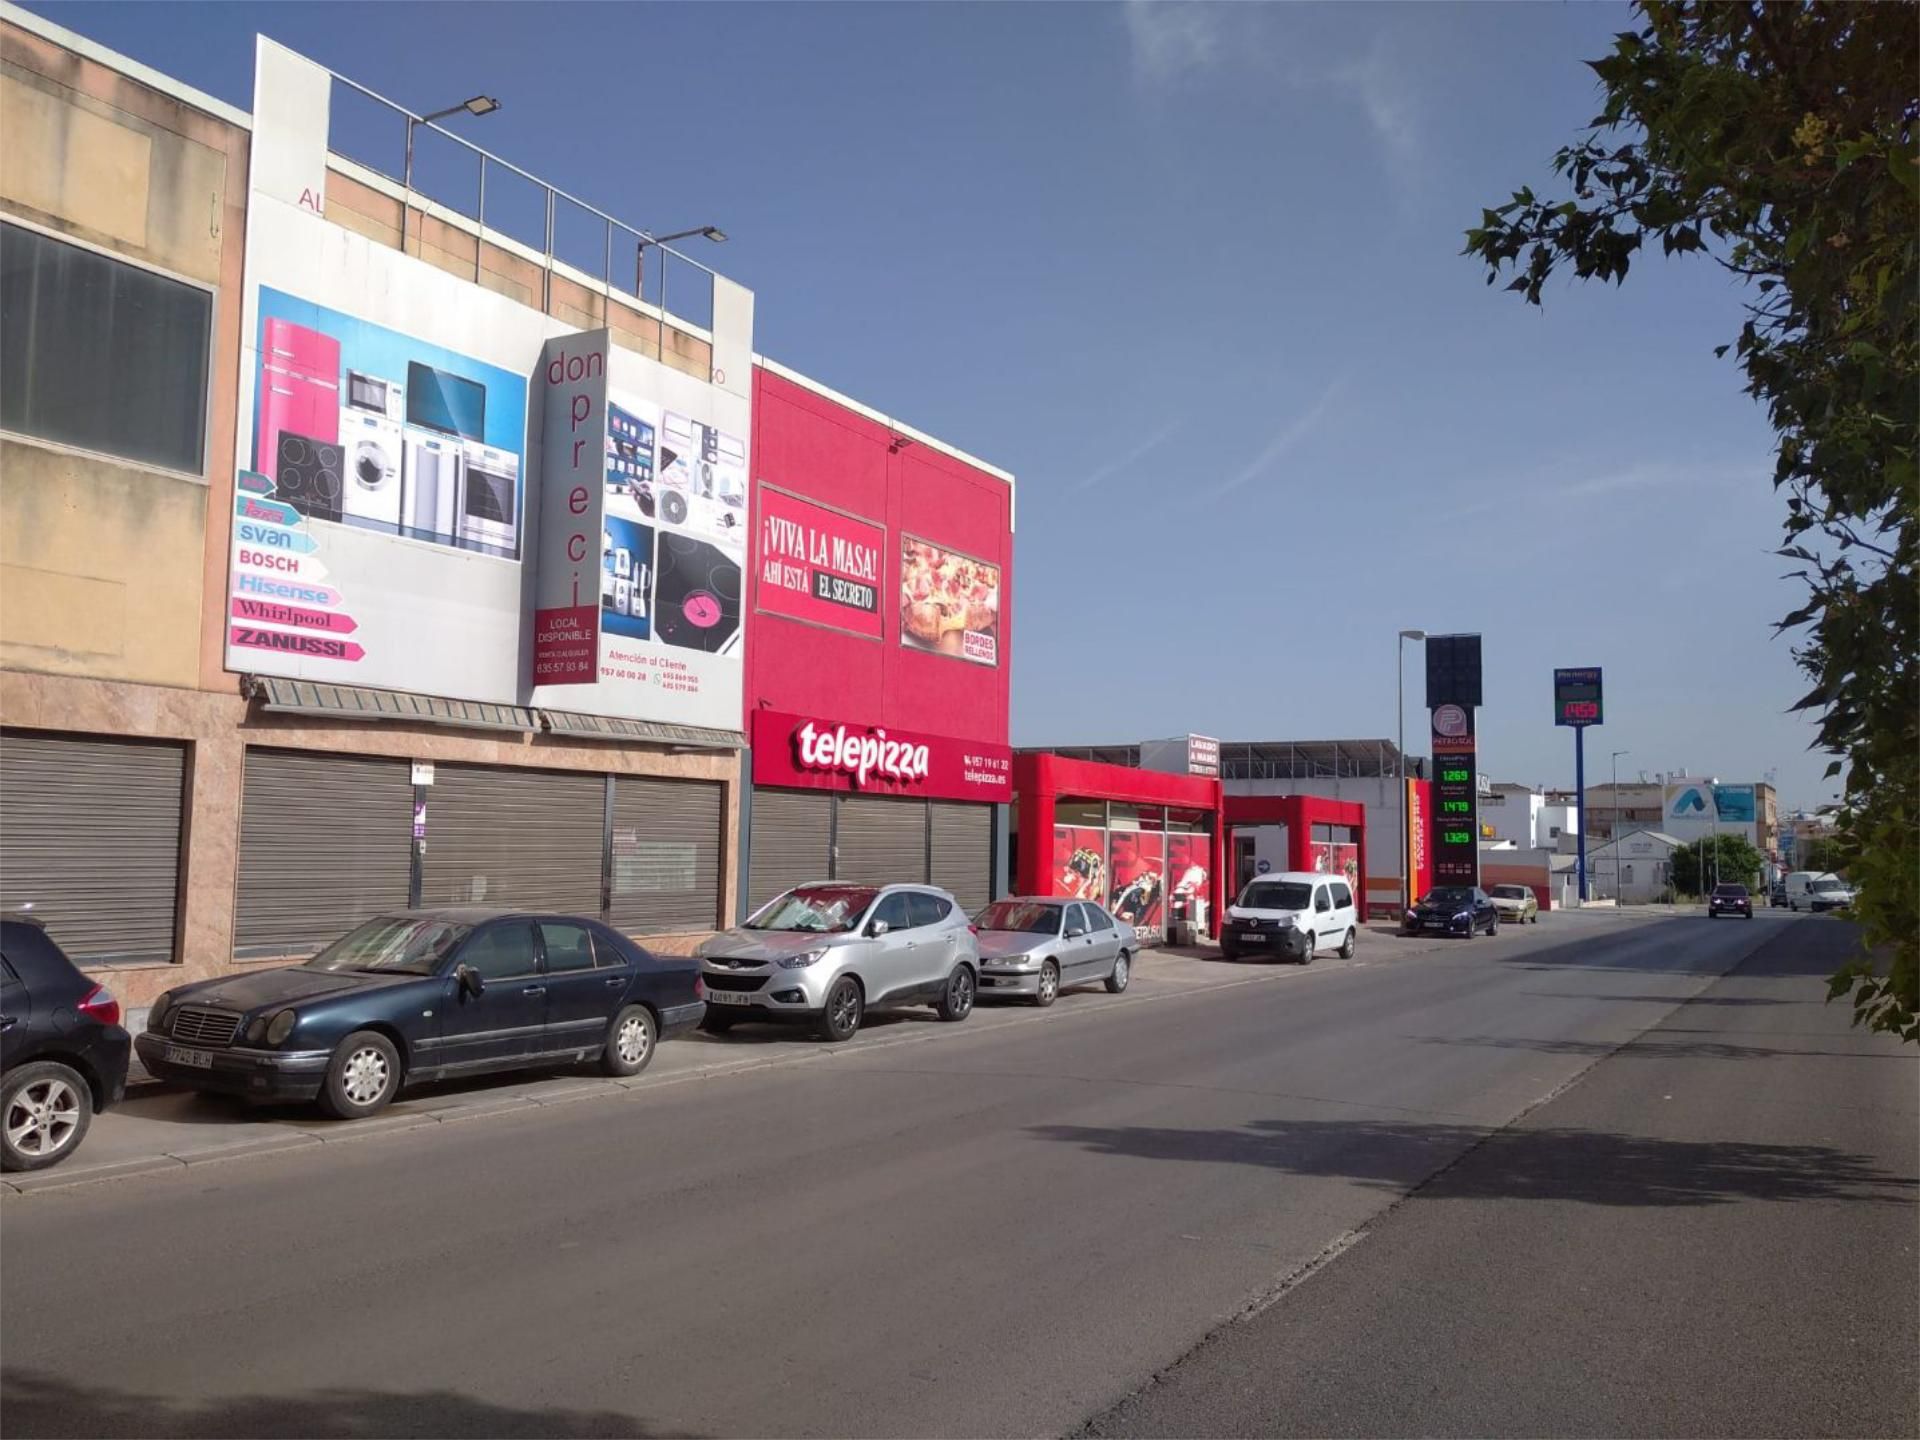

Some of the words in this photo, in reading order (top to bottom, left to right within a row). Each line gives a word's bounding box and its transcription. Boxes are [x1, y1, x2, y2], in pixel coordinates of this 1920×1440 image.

[547, 351, 603, 385] don
[240, 524, 292, 549] svan
[764, 515, 806, 561] ¡VIVA
[809, 528, 829, 568] LA
[832, 535, 877, 581] MASA!
[239, 549, 299, 574] BOSCH
[239, 573, 329, 604] Hisense
[763, 557, 782, 586] AHÍ
[784, 563, 809, 593] ESTÁ
[818, 573, 831, 599] EL
[832, 577, 873, 609] SECRETO
[240, 599, 331, 628] Whirlpool
[550, 617, 578, 629] LOCAL
[237, 628, 346, 657] ZANUSSI
[538, 629, 592, 643] DISPONIBLE
[964, 631, 994, 650] BORDES
[609, 649, 648, 664] Atención
[649, 656, 657, 666] al
[659, 658, 687, 670] Cliente
[965, 645, 994, 661] RELLENOS
[553, 662, 564, 673] 57
[566, 661, 576, 672] 93
[600, 667, 614, 677] 957
[800, 722, 929, 785] telepizza
[964, 768, 1006, 785] telepizza.es
